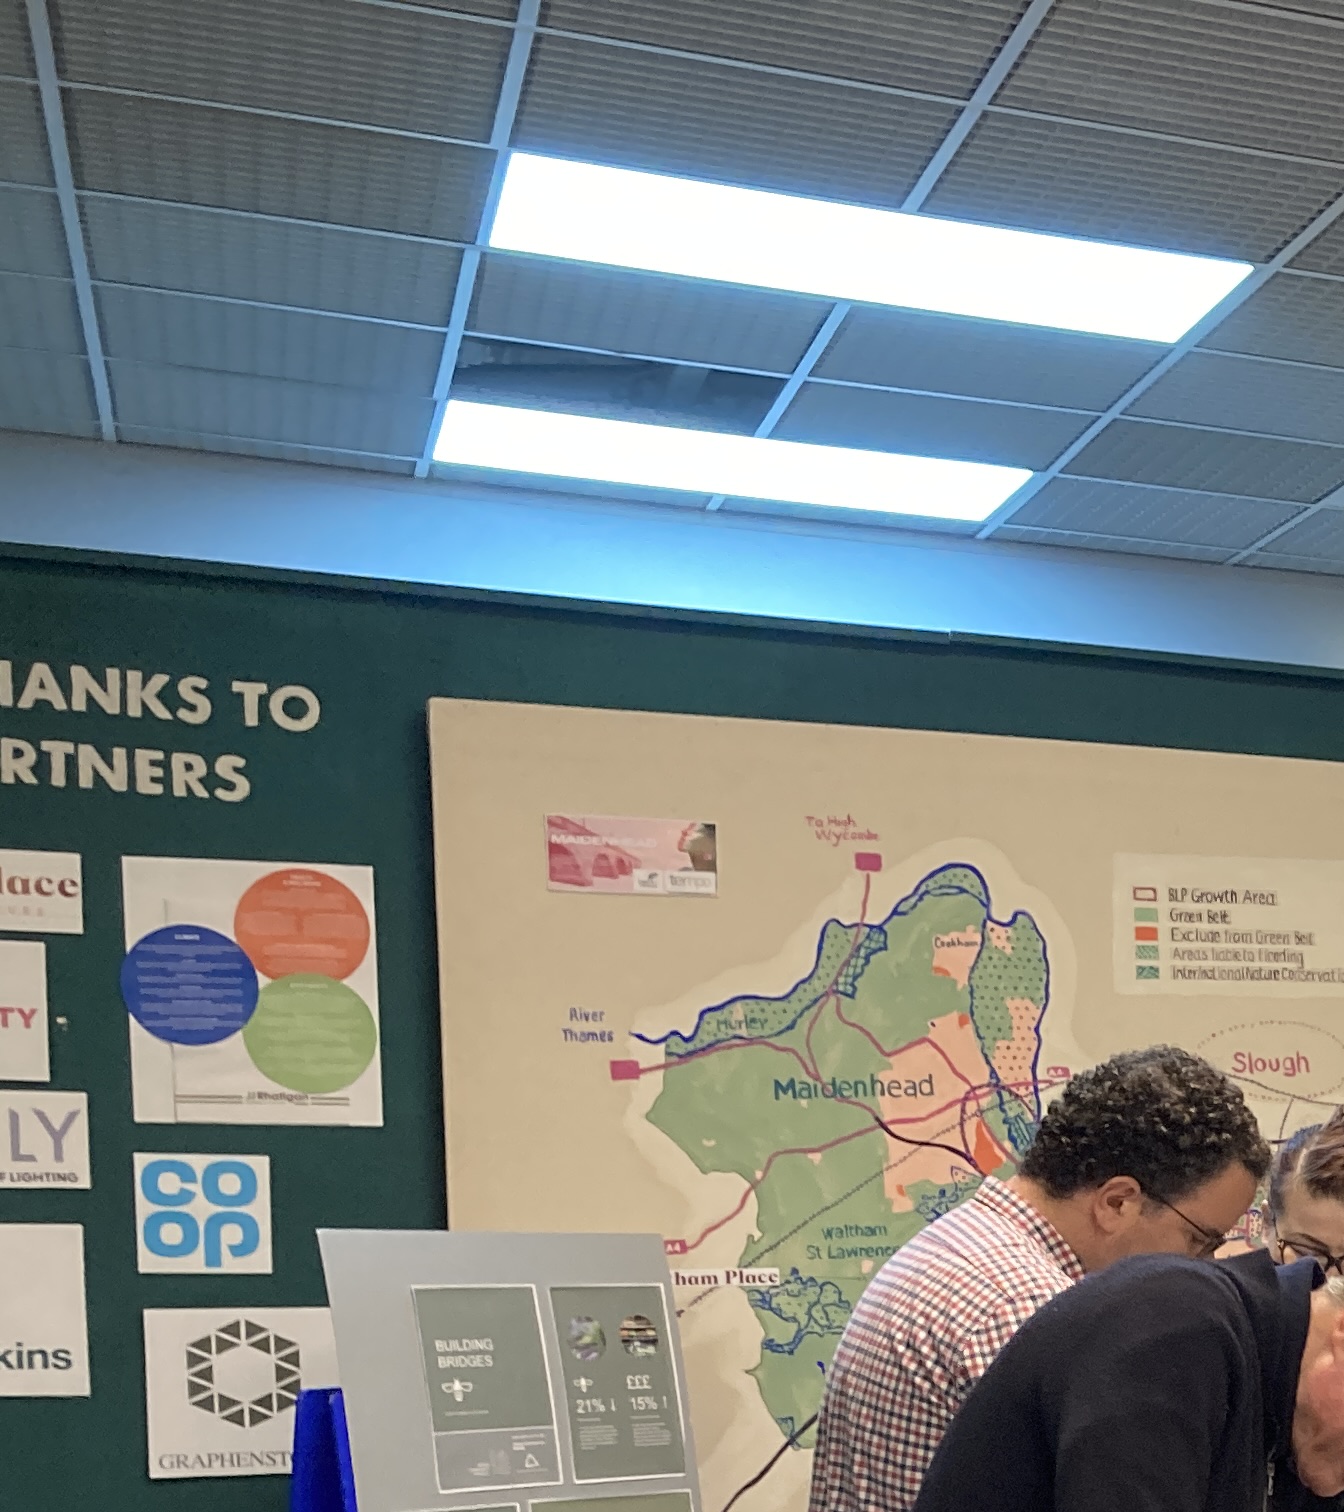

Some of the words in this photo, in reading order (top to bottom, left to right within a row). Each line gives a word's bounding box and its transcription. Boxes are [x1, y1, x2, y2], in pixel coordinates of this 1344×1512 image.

[0, 660, 212, 725] ANKS
[231, 681, 321, 732] TO
[1191, 888, 1238, 904] Growth
[1243, 890, 1275, 906] Area
[1169, 908, 1203, 922] Green
[1207, 909, 1230, 924] Belt
[569, 1007, 604, 1023] River
[716, 1016, 769, 1032] Hurley
[562, 1027, 614, 1043] Thames
[1232, 1051, 1310, 1077] Slough
[773, 1073, 935, 1101] Maidenhead
[9, 1107, 81, 1164] LY
[10, 1171, 78, 1183] LIGHTING
[665, 1242, 682, 1253] A4
[806, 1244, 823, 1260] St
[724, 1270, 779, 1285] Place
[434, 1338, 494, 1353] BUILDING
[437, 1355, 494, 1369] BRIDGES
